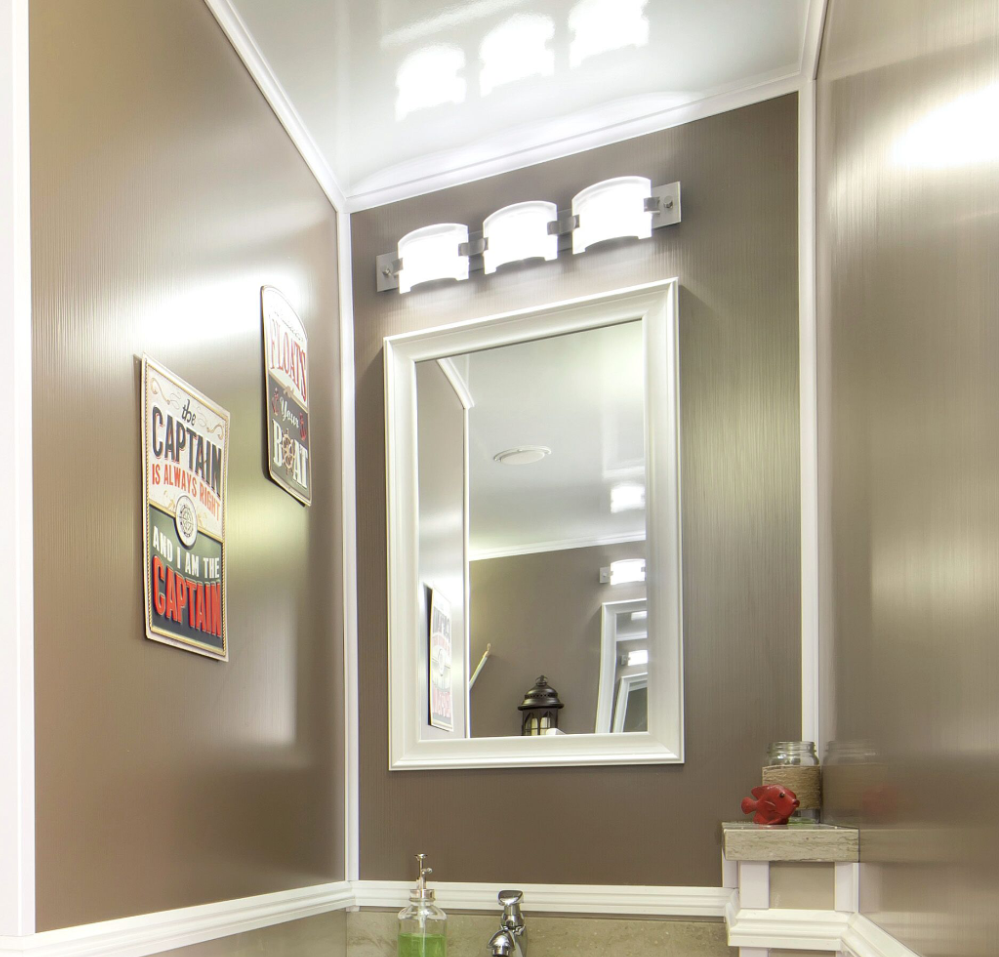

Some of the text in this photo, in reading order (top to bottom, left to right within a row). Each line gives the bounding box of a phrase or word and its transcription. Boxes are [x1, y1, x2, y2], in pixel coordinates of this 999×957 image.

[270, 315, 306, 402] FLOATS
[181, 399, 197, 426] the
[152, 406, 222, 499] CAPTAIN
[152, 464, 220, 521] IS ALWAYS RIGHT
[153, 525, 220, 579] AND I AM THE
[153, 556, 221, 637] CAPTAIN
